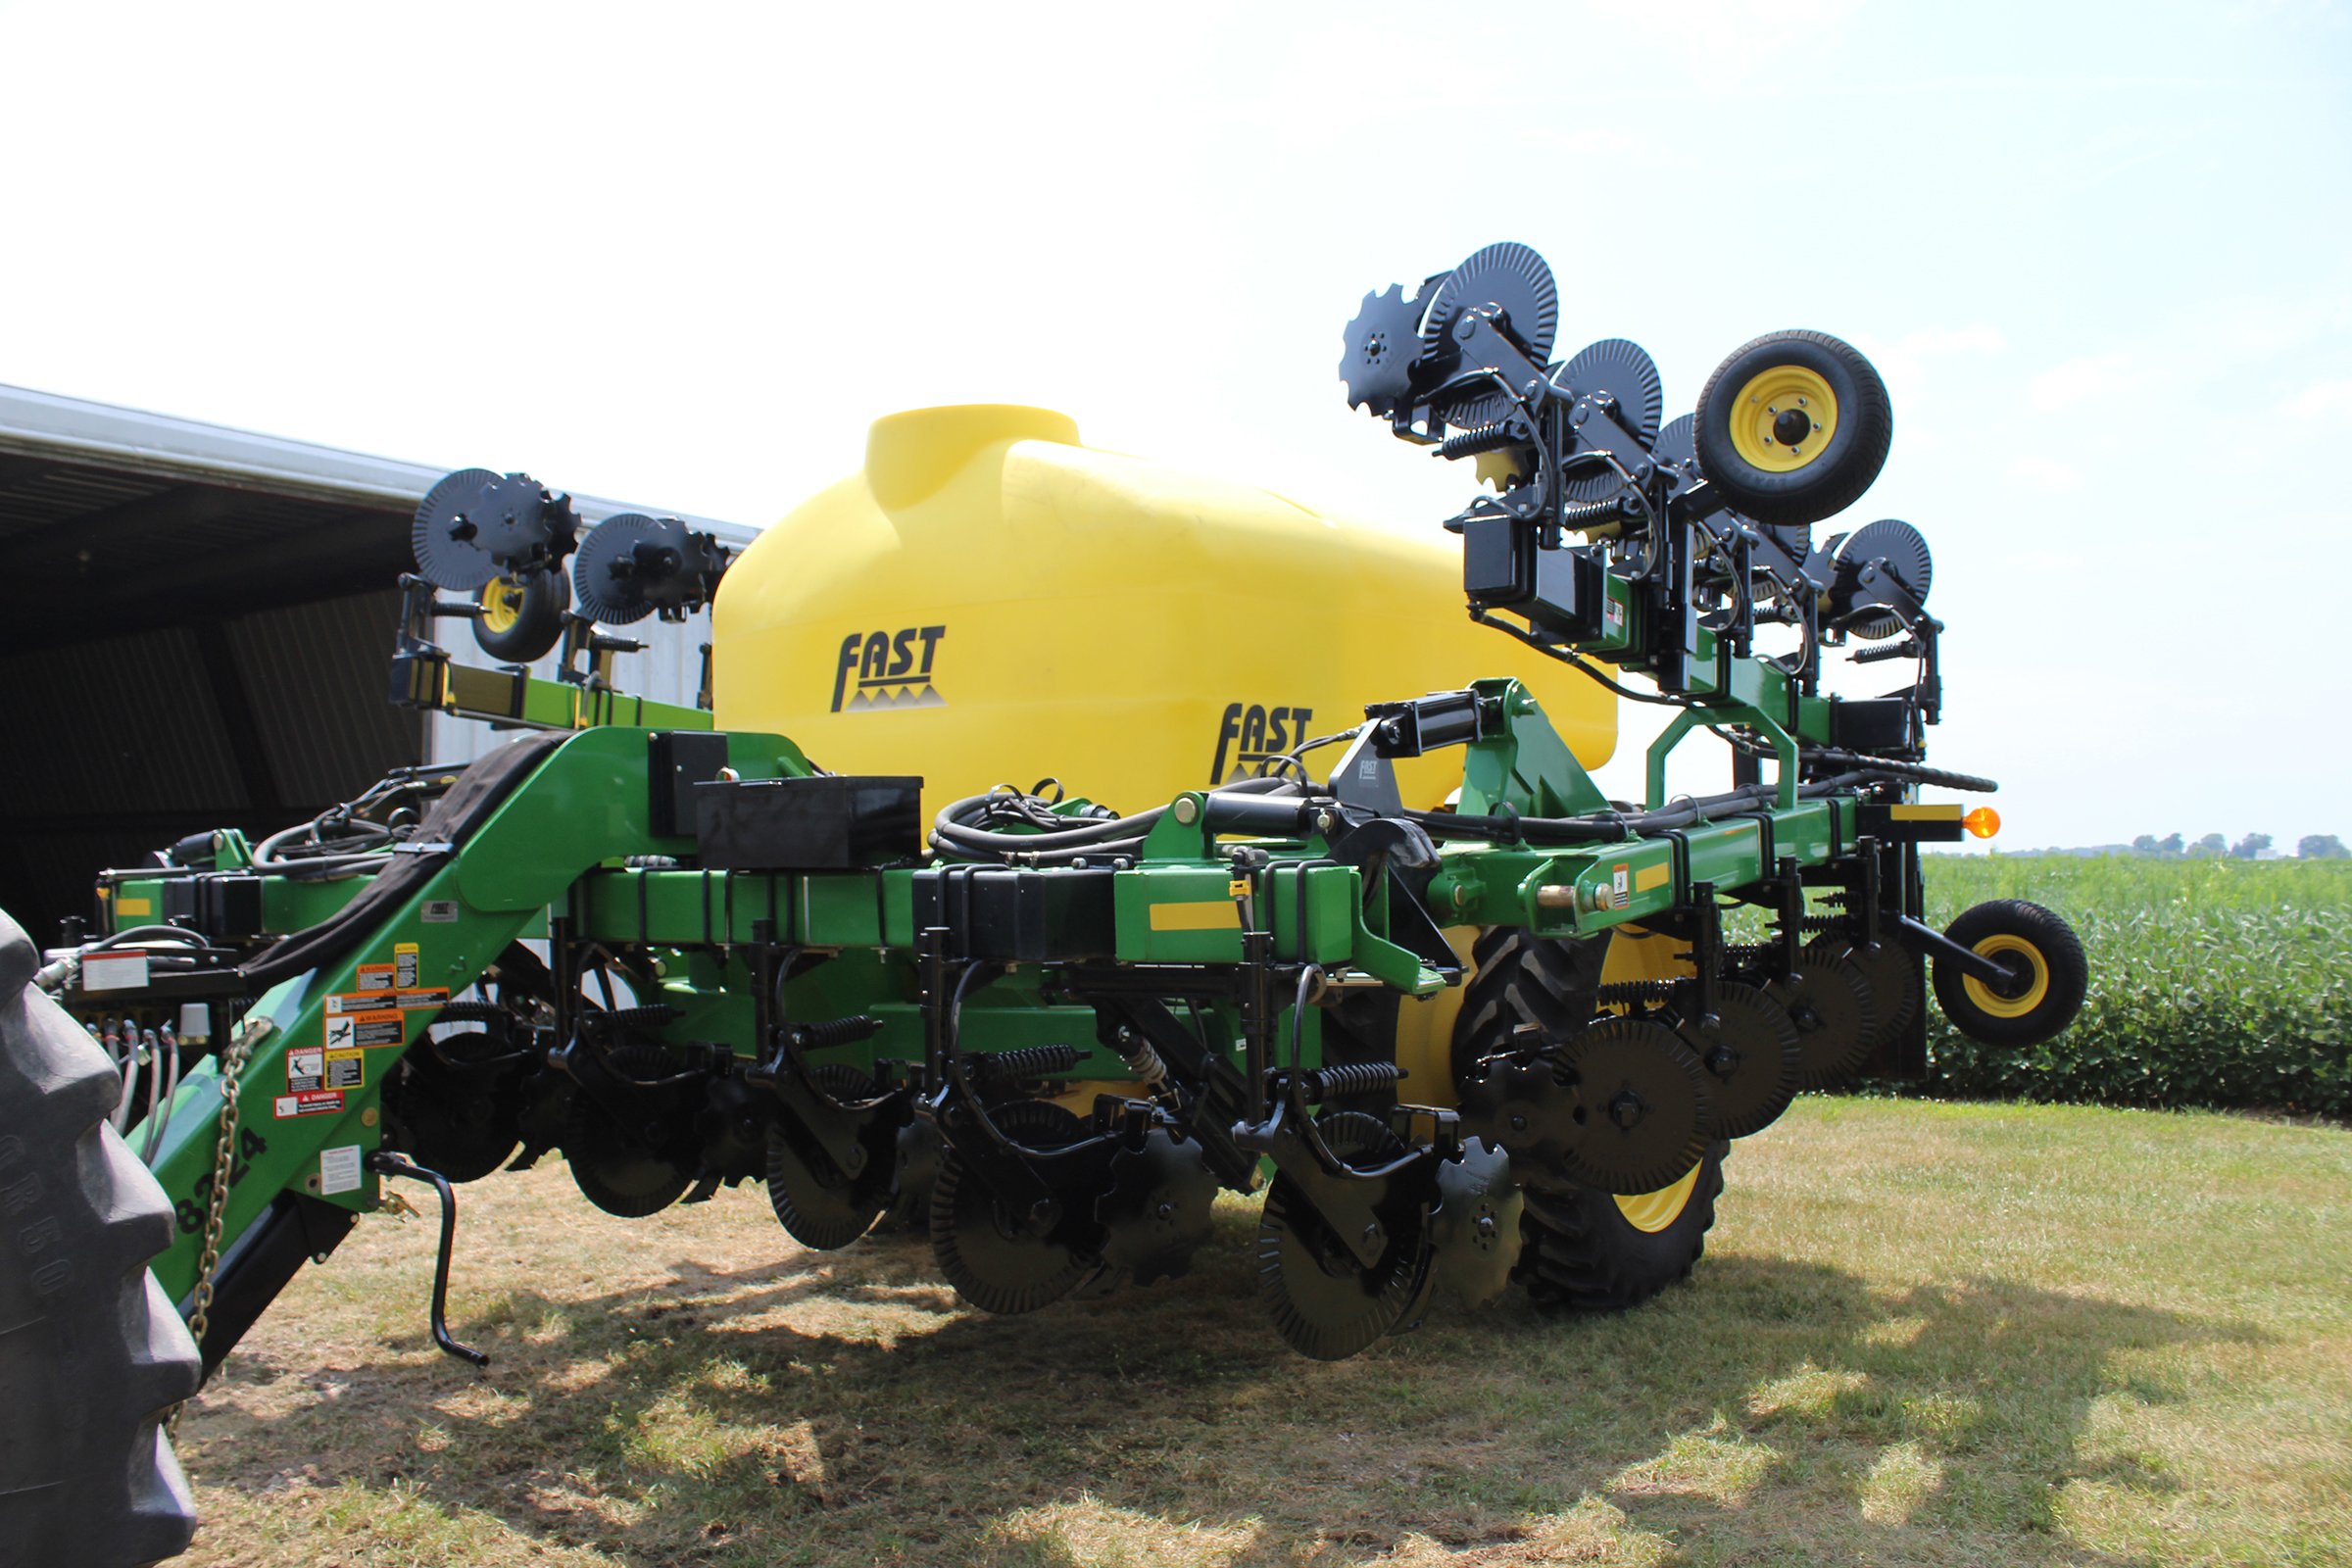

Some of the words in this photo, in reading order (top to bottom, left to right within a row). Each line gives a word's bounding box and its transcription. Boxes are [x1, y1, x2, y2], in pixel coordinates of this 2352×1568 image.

[831, 625, 946, 712] FAST
[1209, 703, 1312, 785] FAST
[1359, 760, 1378, 779] FAST
[311, 1092, 337, 1101] DANGER
